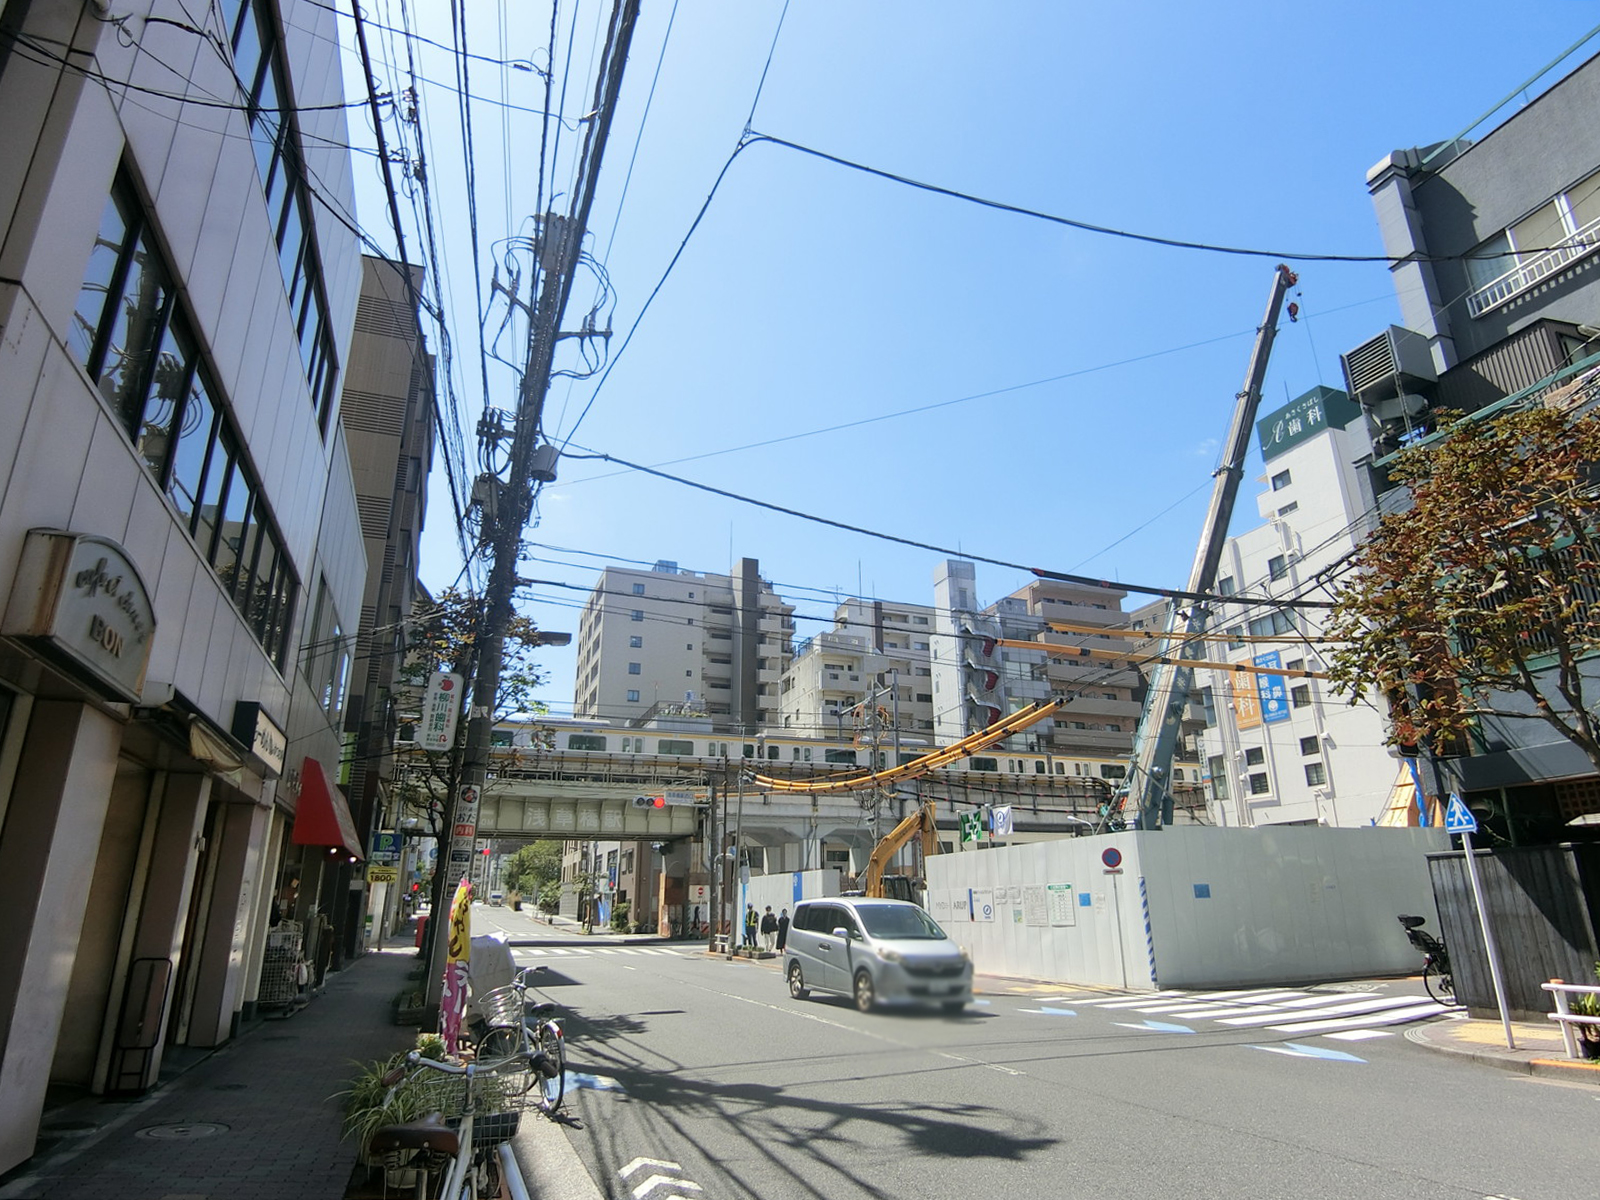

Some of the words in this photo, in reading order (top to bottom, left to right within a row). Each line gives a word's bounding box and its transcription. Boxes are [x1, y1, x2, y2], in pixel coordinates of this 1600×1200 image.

[1285, 396, 1319, 420] あさくさばし
[1287, 405, 1322, 437] 歯科
[89, 614, 123, 659] BON
[1235, 670, 1255, 718] 歯科
[433, 692, 450, 732] 柳川歯科
[455, 826, 473, 836] 内科
[457, 812, 477, 824] おだ
[527, 807, 622, 828] 浅草橋駅
